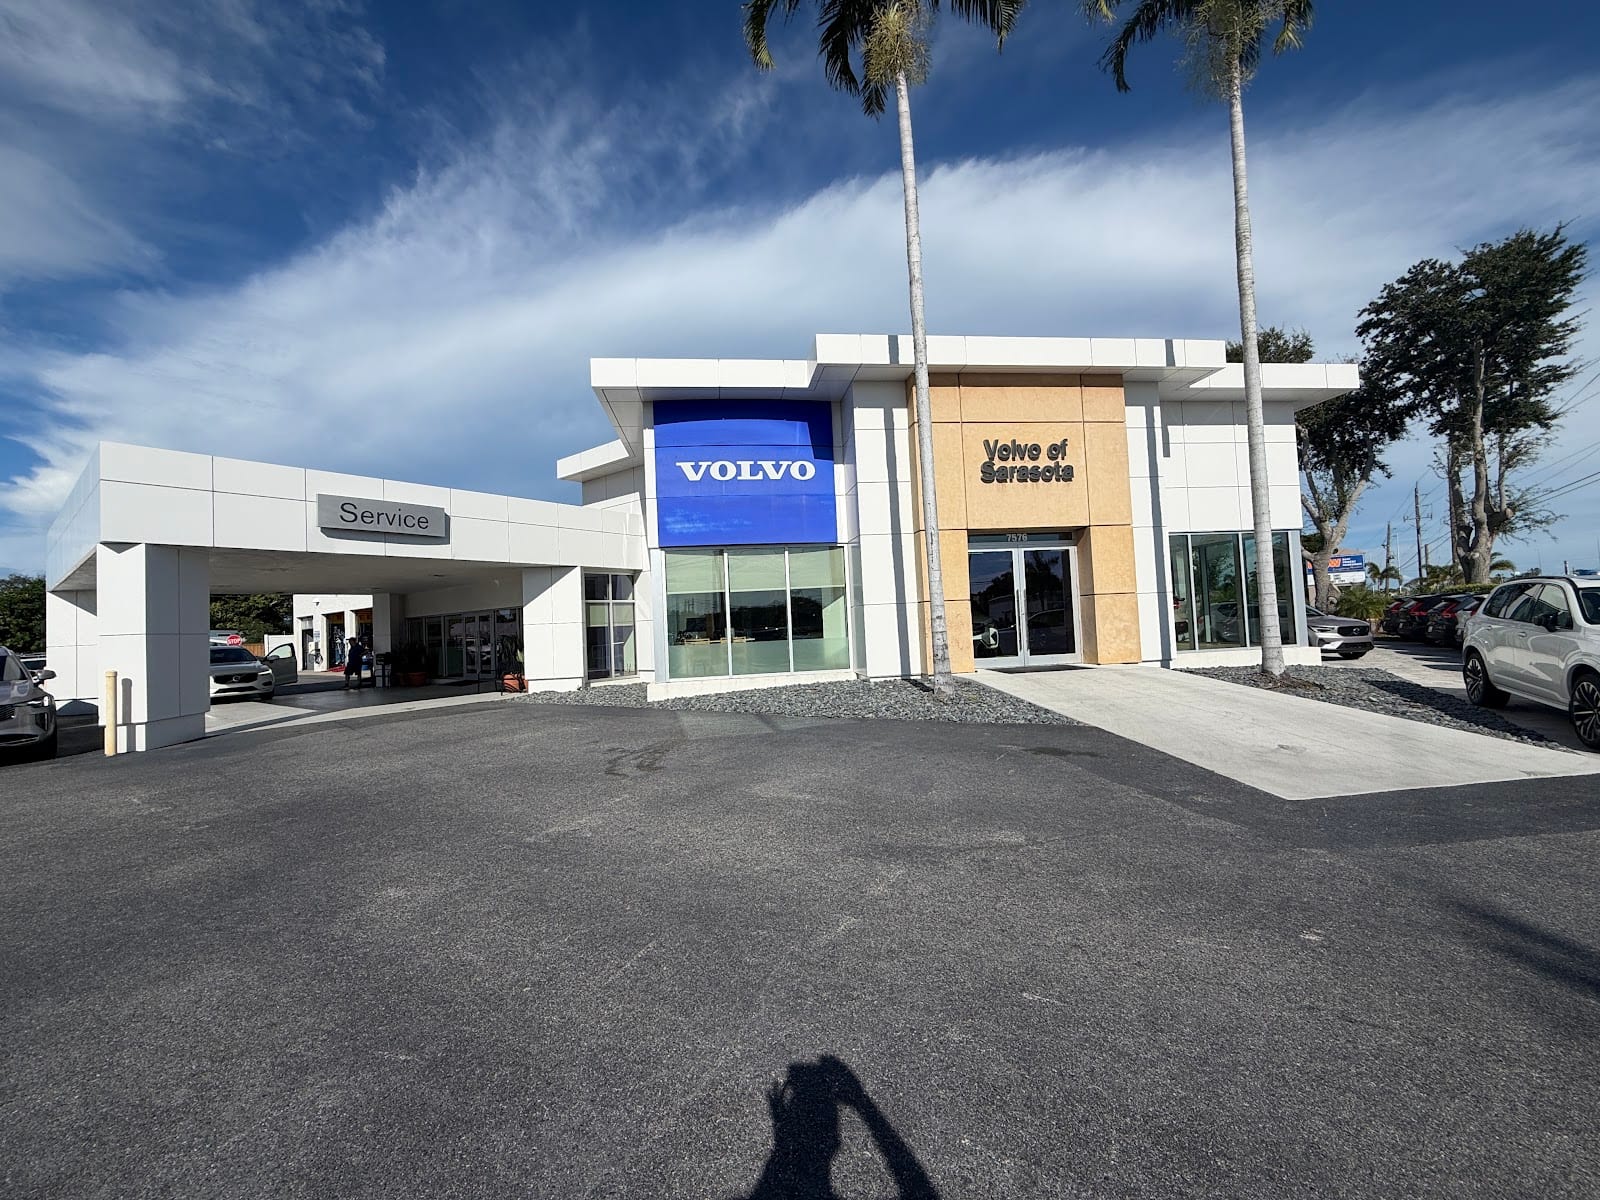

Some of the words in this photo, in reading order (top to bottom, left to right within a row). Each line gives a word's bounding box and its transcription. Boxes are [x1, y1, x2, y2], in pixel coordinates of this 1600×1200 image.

[983, 439, 1041, 461] Volvo
[1047, 438, 1068, 460] of
[675, 460, 816, 481] VOLVO
[981, 461, 1074, 483] Sarasota
[339, 502, 429, 529] Service
[1006, 533, 1028, 542] 7576
